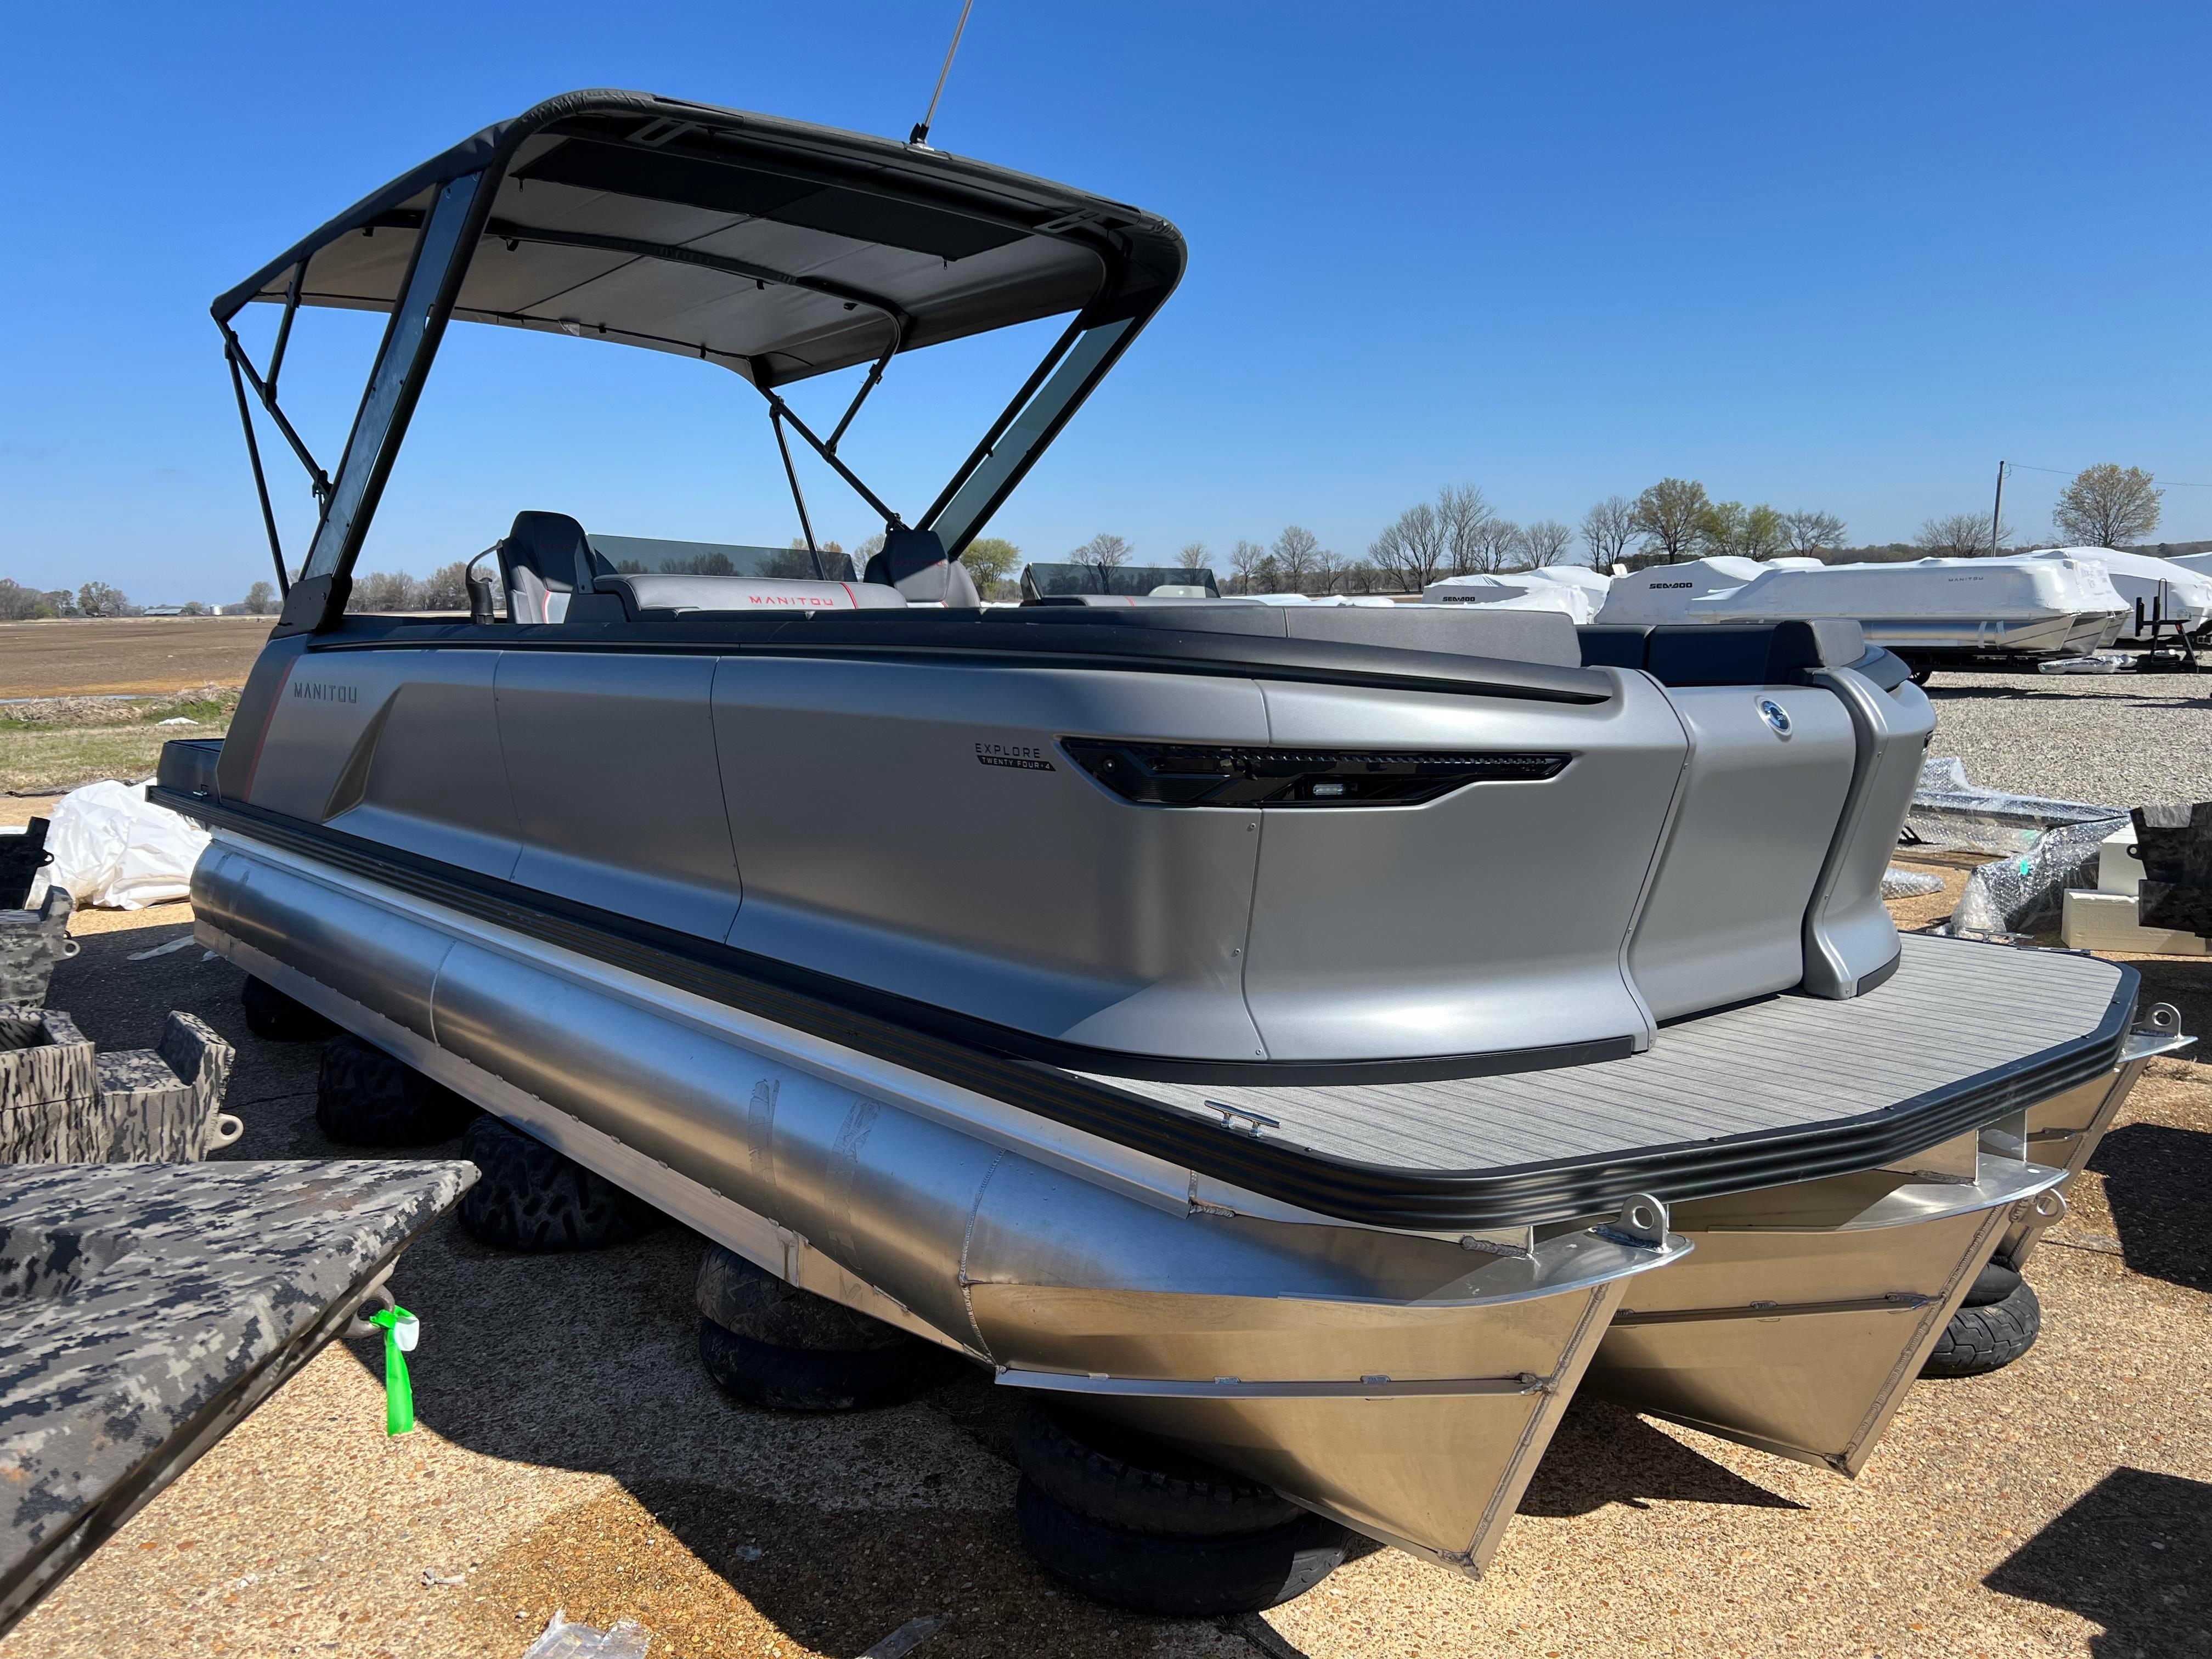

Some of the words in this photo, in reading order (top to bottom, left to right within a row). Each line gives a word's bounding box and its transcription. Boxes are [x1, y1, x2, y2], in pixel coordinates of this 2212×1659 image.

[749, 596, 834, 606] MANITOU
[294, 682, 357, 704] MANITOU
[975, 743, 1041, 759] EXPLORE
[981, 757, 1013, 766] TWENTY
